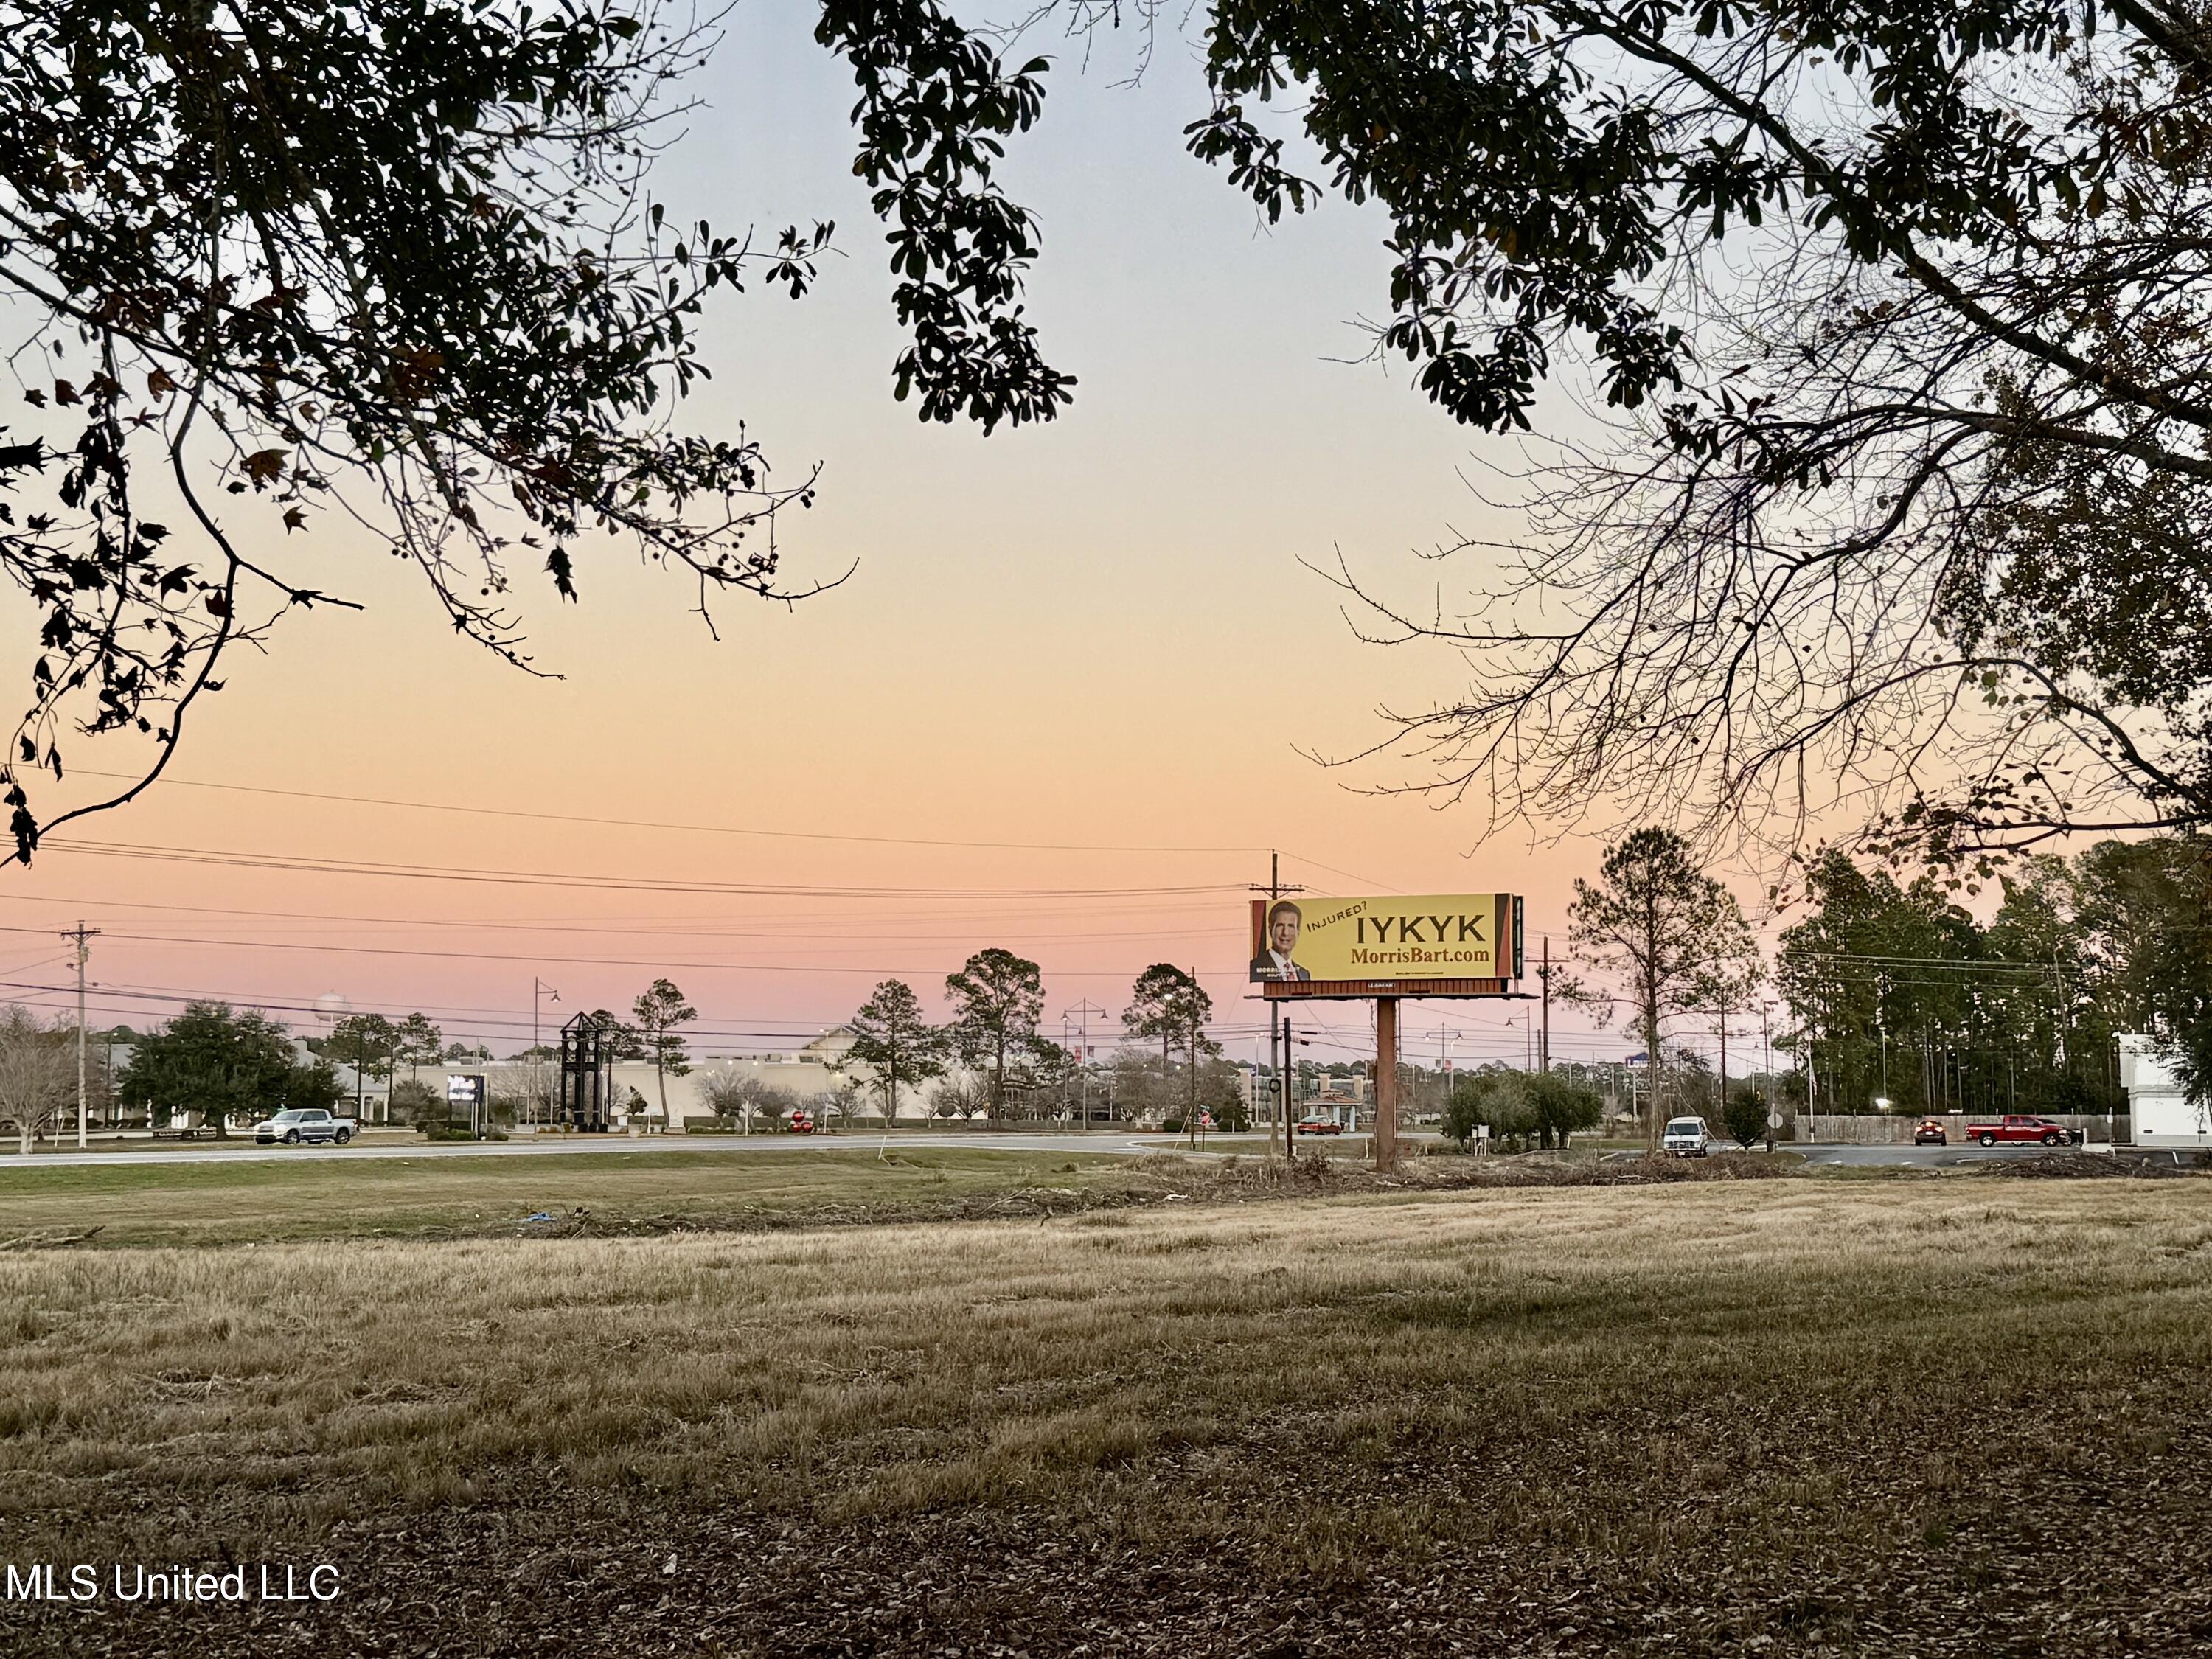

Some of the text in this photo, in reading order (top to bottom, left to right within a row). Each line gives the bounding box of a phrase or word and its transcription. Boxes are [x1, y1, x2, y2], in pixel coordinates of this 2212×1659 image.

[1307, 901, 1367, 933] INJURED?
[1357, 915, 1486, 943] IYKYK
[1351, 948, 1489, 964] MorrisBart.com
